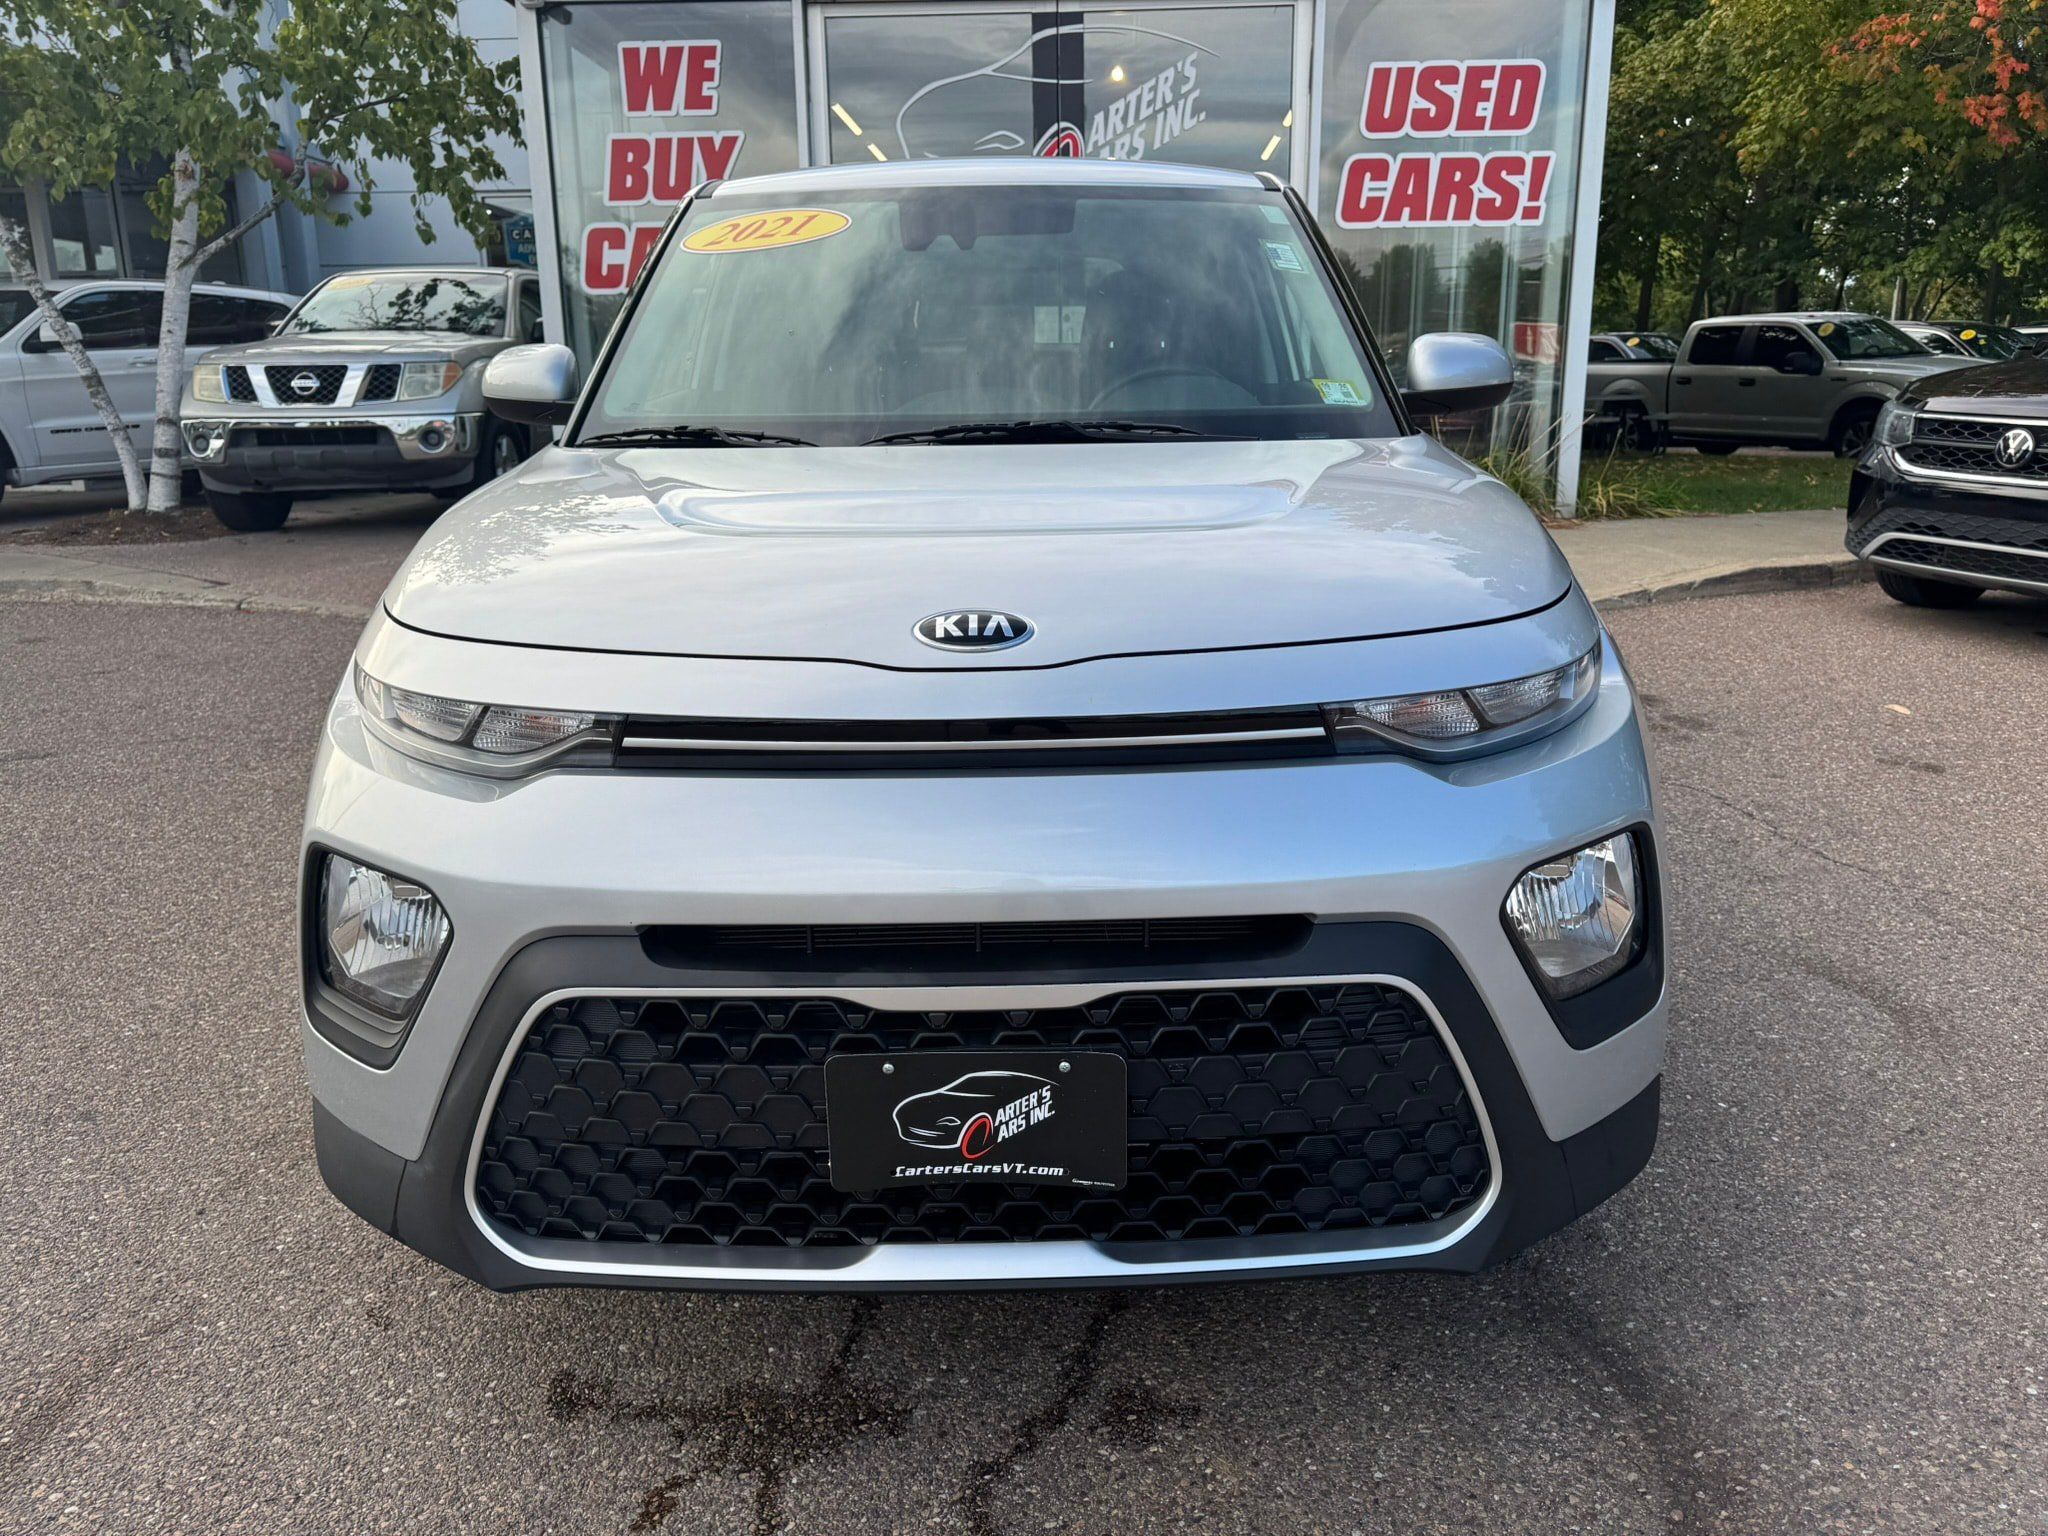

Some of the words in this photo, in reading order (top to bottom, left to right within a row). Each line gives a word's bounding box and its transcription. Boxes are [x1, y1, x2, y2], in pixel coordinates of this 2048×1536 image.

[619, 42, 719, 115] WE
[1362, 62, 1543, 135] USED
[1153, 88, 1206, 150] INC.
[606, 133, 742, 204] BUY
[1338, 153, 1553, 226] CARS!
[702, 212, 821, 249] 2021
[934, 613, 1015, 639] KIA
[1030, 1100, 1056, 1126] INC.
[895, 1162, 1064, 1178] CartersCarsVT.com
